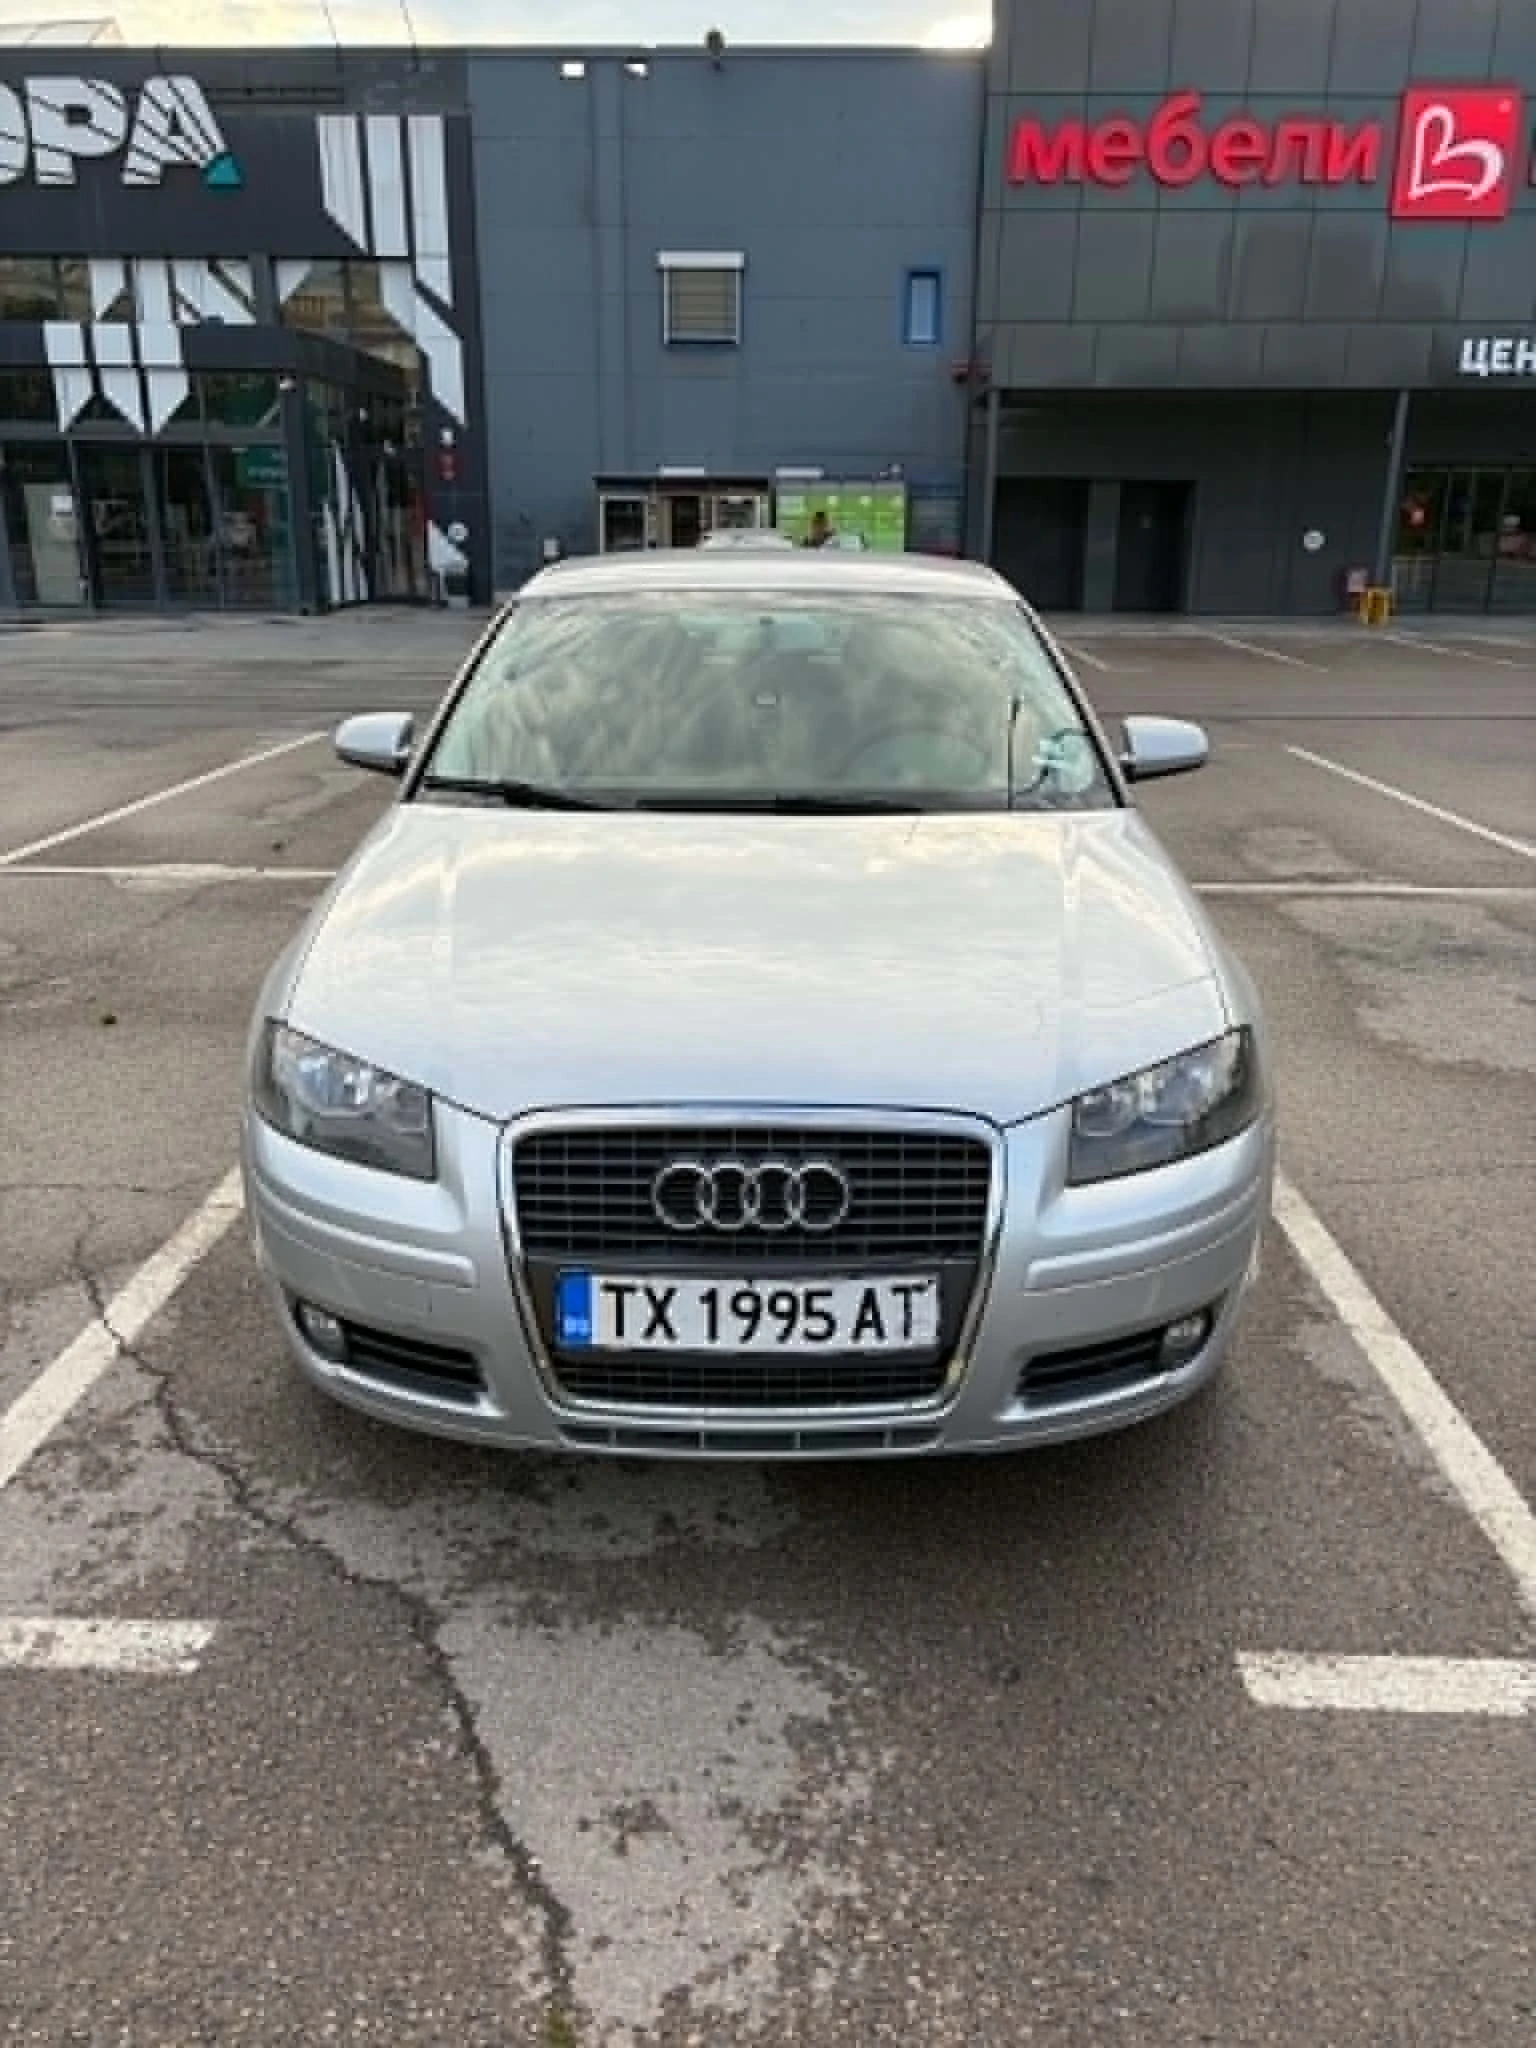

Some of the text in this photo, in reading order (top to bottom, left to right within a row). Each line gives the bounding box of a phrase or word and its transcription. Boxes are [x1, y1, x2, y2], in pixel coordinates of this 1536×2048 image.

[0, 75, 241, 184] РА
[1008, 90, 1382, 185] мебели
[1460, 337, 1536, 376] ЦЕН
[602, 1283, 926, 1343] TX 1995 AT
